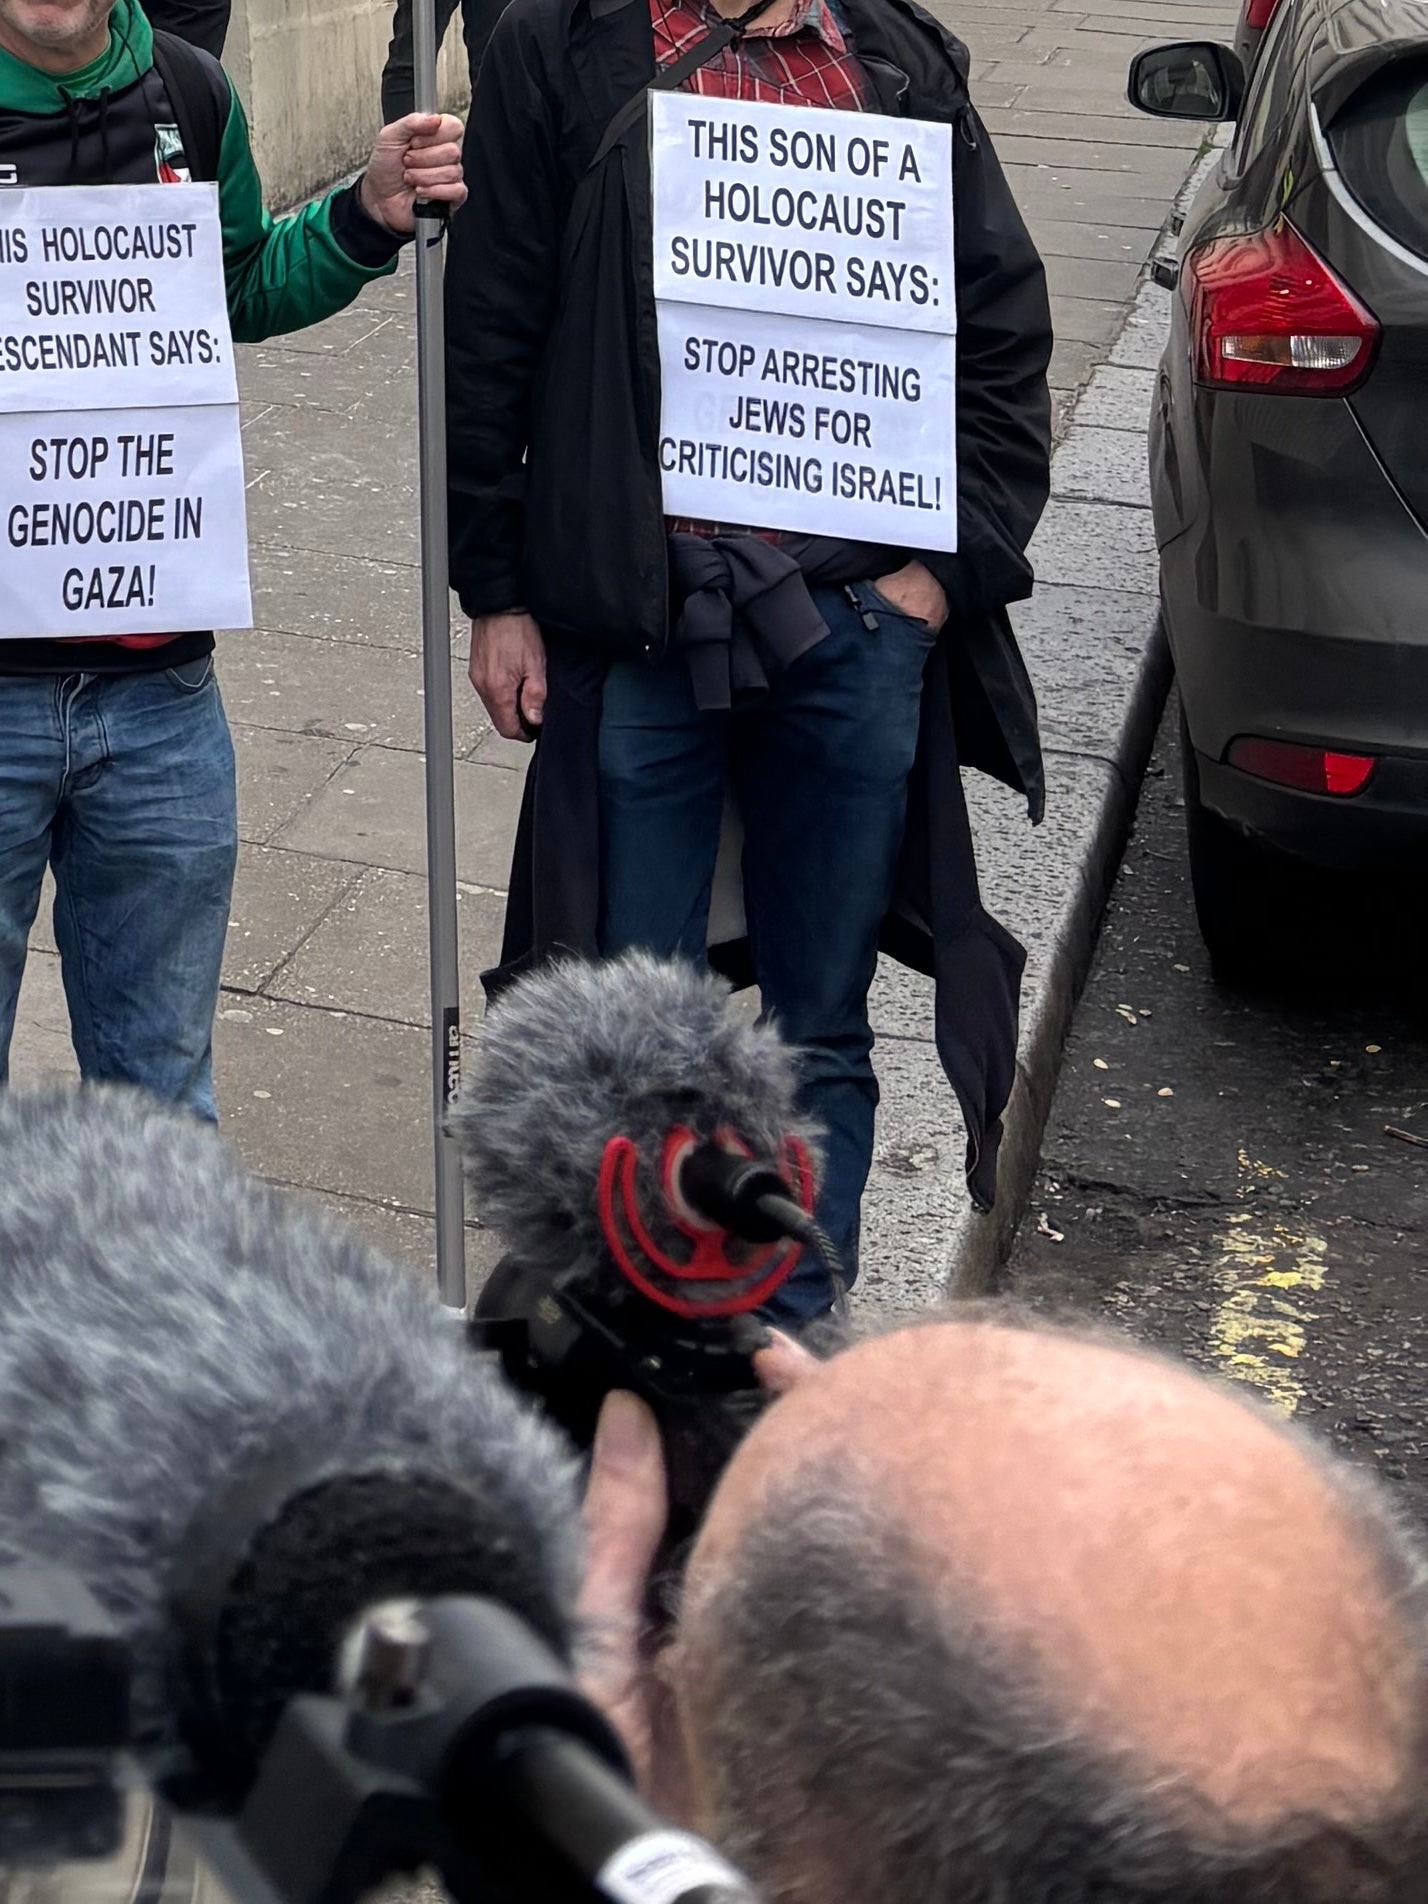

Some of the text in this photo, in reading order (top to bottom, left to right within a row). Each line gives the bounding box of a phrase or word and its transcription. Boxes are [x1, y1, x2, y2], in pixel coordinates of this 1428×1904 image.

[687, 119, 922, 183] THIS SON OF A
[705, 180, 906, 241] HOLOCAUST
[42, 223, 197, 261] HOLOCAUST
[26, 278, 156, 317] SURVIVOR
[670, 236, 940, 306] SURVIVOR SAYS:
[149, 329, 222, 366] SAYS:
[684, 336, 921, 402] STOP ARRESTING
[729, 395, 872, 449] JEWS FOR
[30, 433, 174, 482] STOP THE
[659, 437, 941, 511] CRITICISING ISRAEL!
[8, 496, 203, 548] GENOCIDE IN
[62, 565, 157, 612] GAZA!
